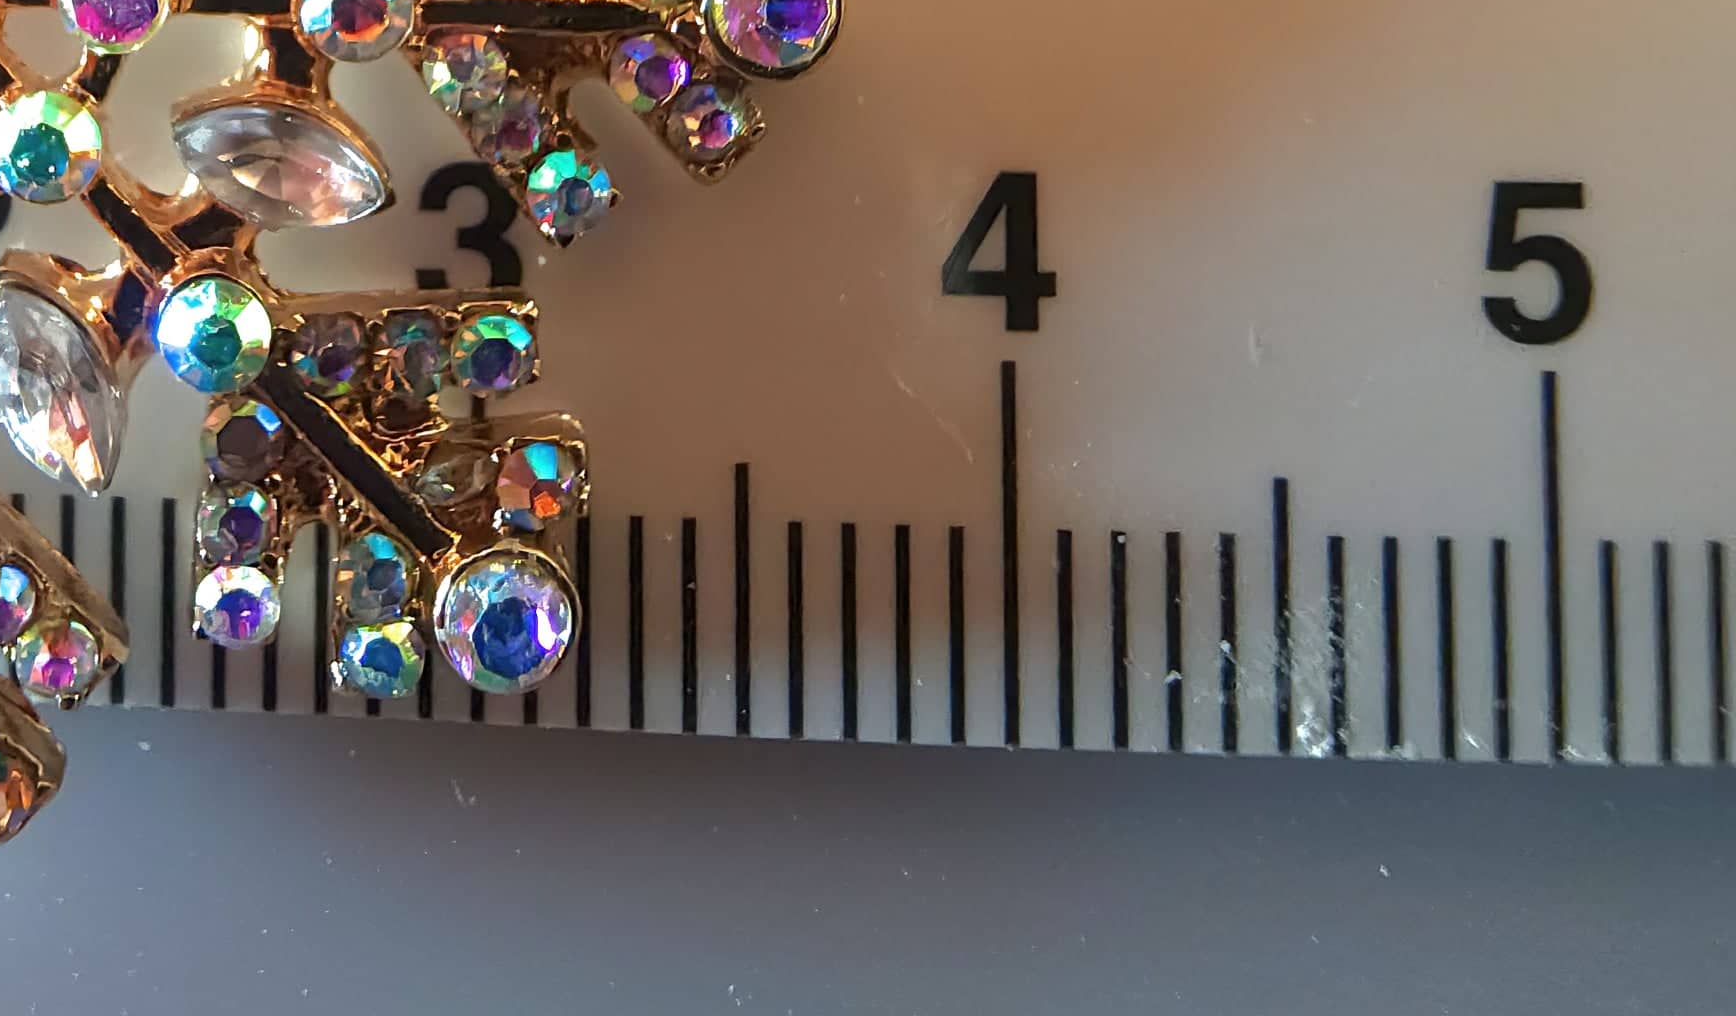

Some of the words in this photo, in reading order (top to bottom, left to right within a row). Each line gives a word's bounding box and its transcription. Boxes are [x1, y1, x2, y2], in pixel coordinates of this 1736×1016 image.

[417, 161, 524, 290] 3
[941, 171, 1057, 333] 4
[1480, 180, 1593, 346] 5
